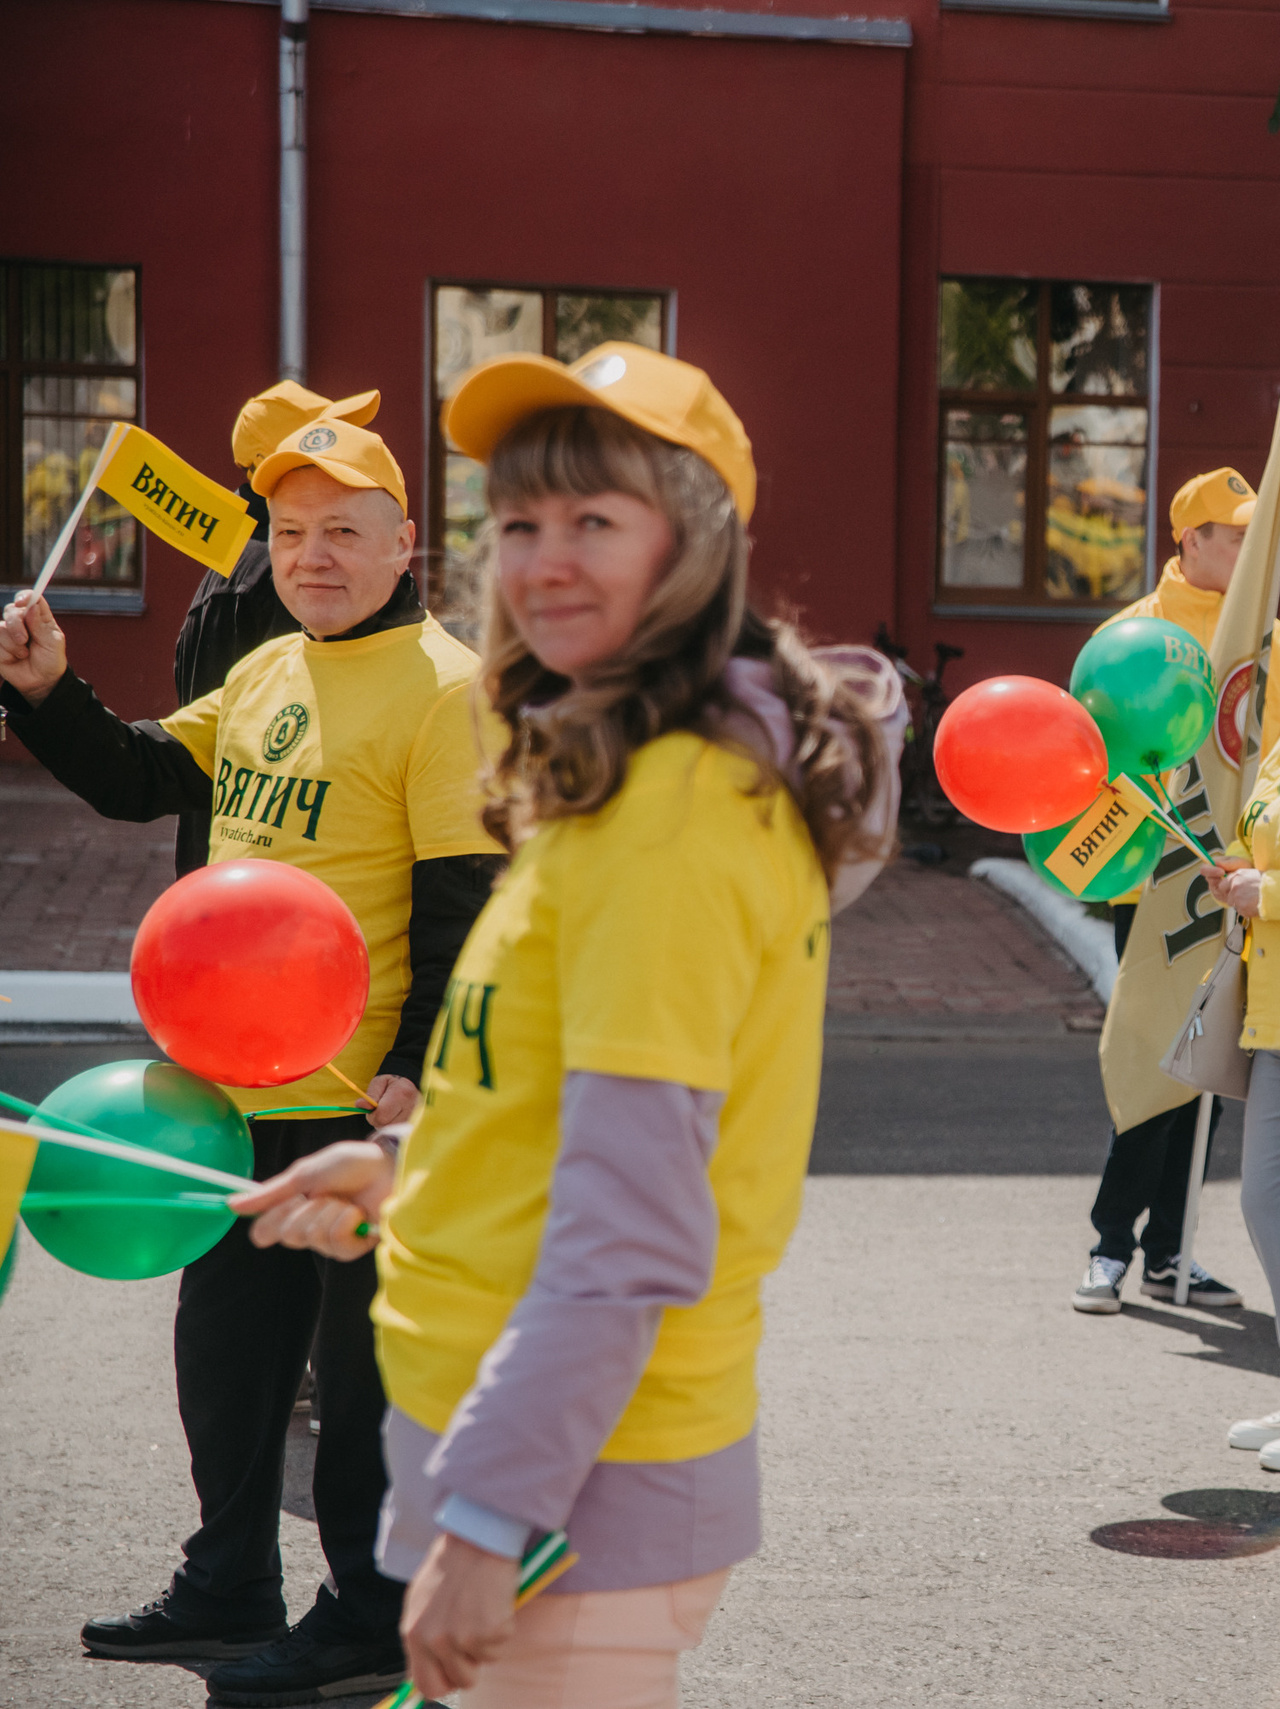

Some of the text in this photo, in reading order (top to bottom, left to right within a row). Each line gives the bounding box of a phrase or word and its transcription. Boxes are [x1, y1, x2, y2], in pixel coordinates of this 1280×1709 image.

[131, 462, 220, 544] ВЯТИЧ
[214, 757, 332, 841] ВЯТИЧ
[1070, 800, 1129, 868] ВЯТИЧ
